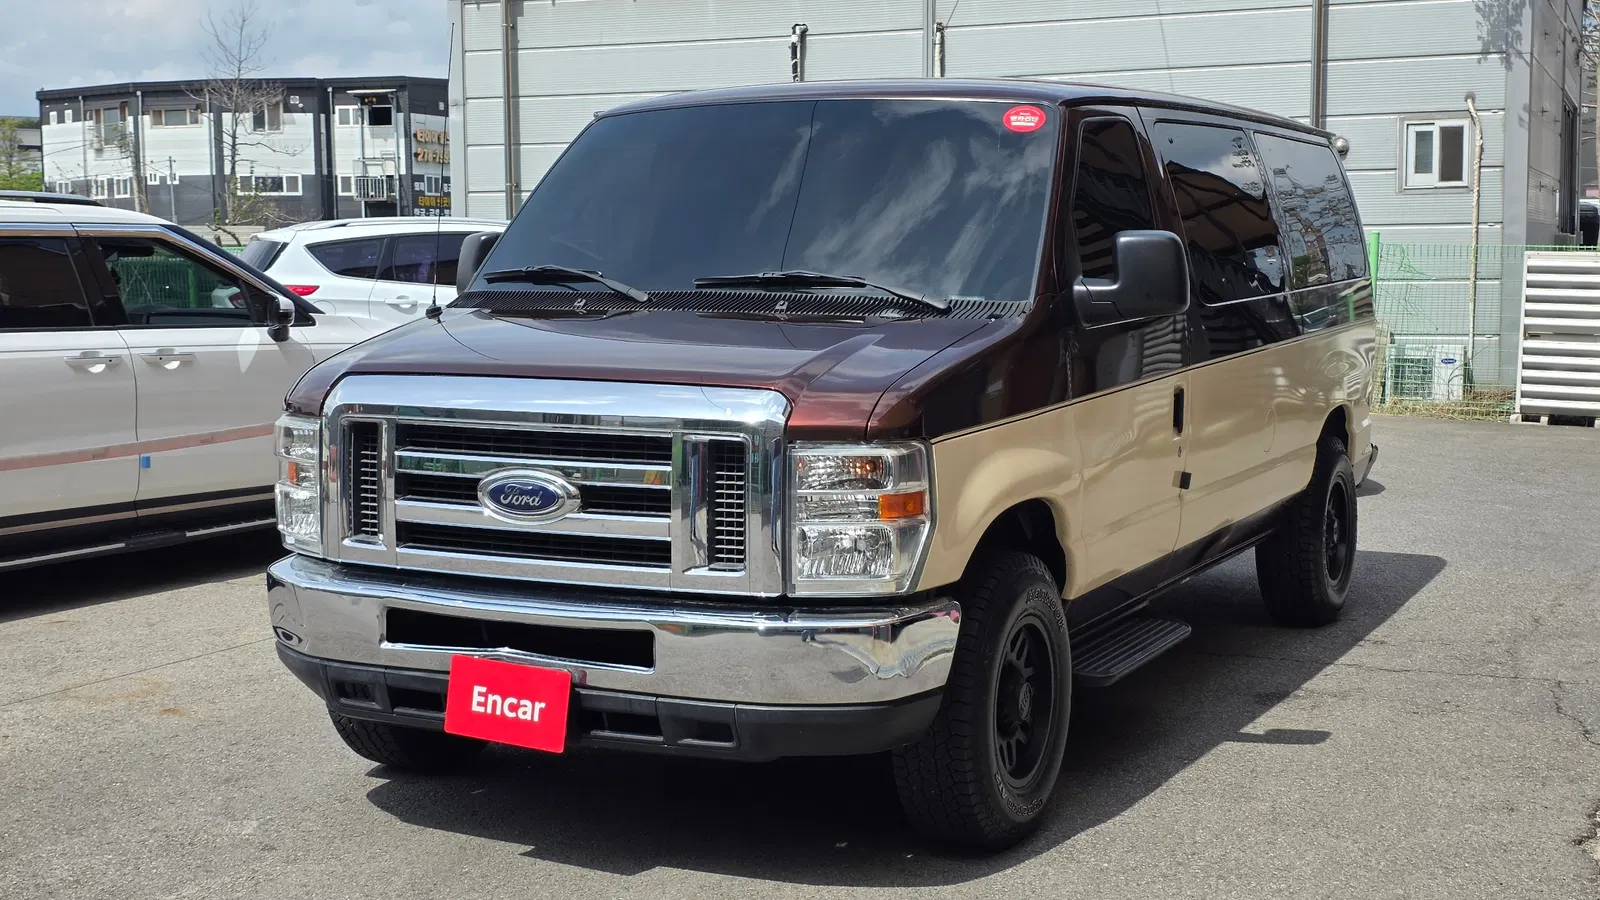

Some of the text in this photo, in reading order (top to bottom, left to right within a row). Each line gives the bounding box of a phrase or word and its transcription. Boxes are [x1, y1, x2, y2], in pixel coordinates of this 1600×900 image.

[416, 128, 438, 143] 타이어
[418, 196, 436, 207] 타이어
[500, 483, 543, 506] Ford
[471, 685, 546, 722] Encar
